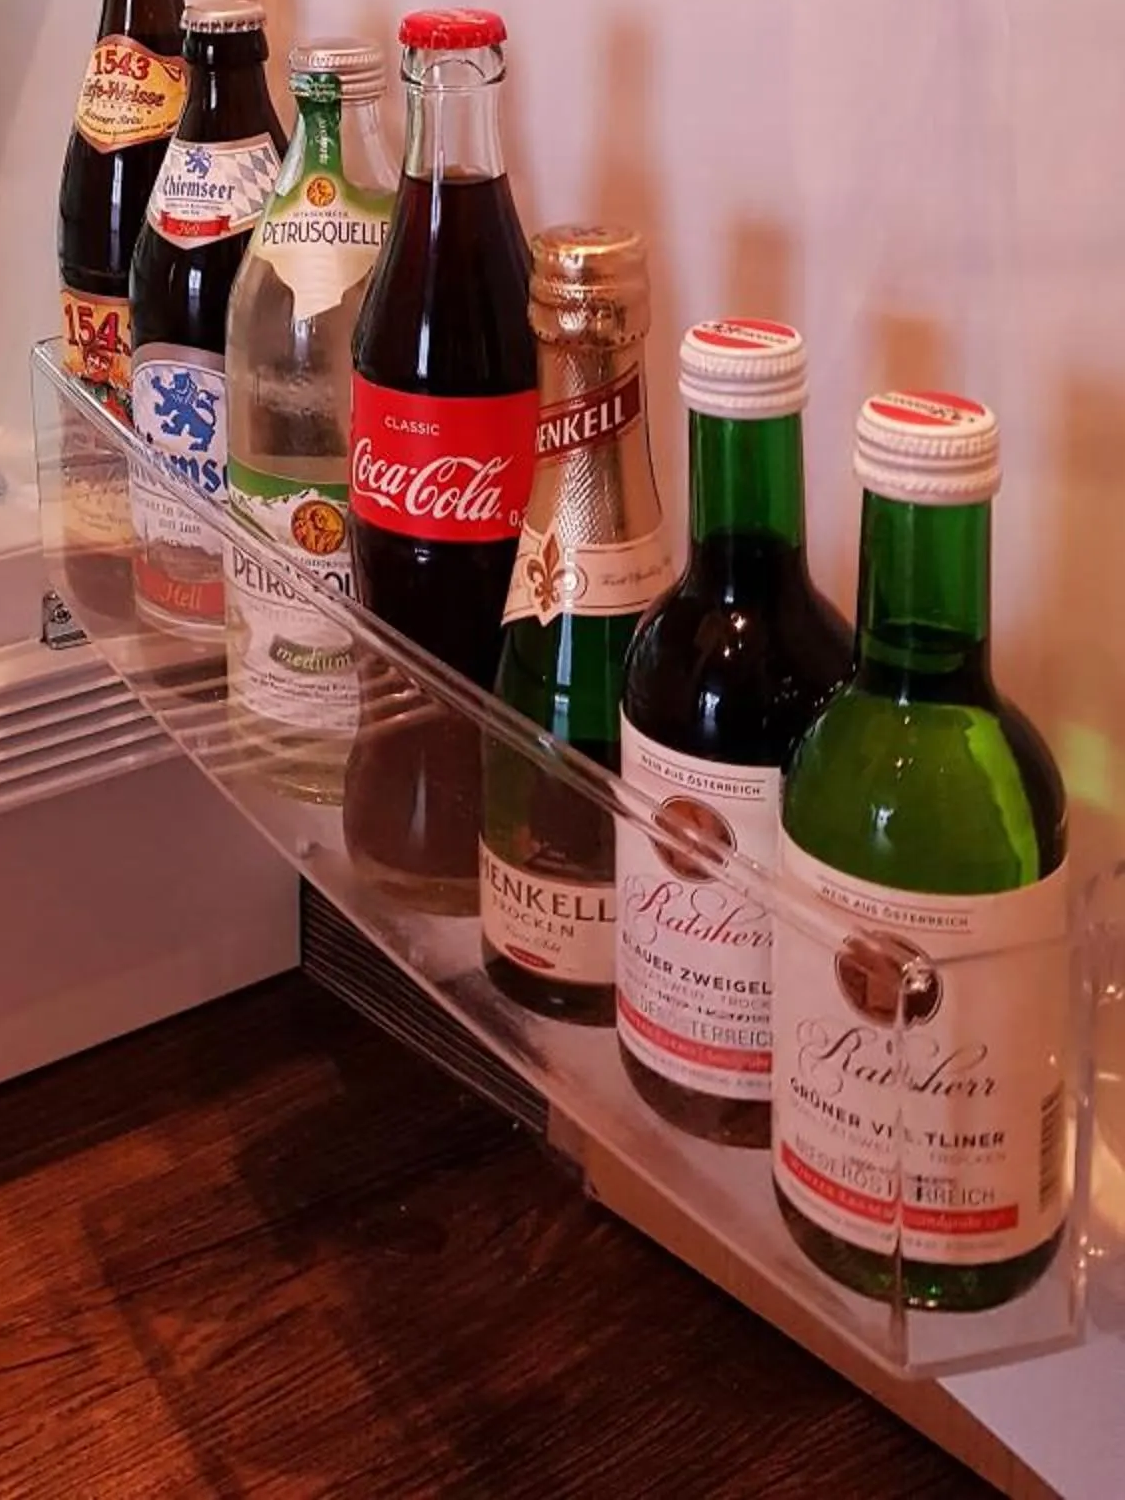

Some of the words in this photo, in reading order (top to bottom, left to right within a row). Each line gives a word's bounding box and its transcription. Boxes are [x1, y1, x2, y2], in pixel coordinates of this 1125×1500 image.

[95, 49, 151, 81] 1543
[162, 174, 236, 200] Chiemseer
[64, 302, 132, 358] 154
[383, 415, 441, 437] CLASSIC
[352, 436, 515, 522] Coca-Cola
[275, 644, 352, 672] medium
[664, 767, 685, 783] AUS
[686, 774, 762, 796] ÖSTERREICH
